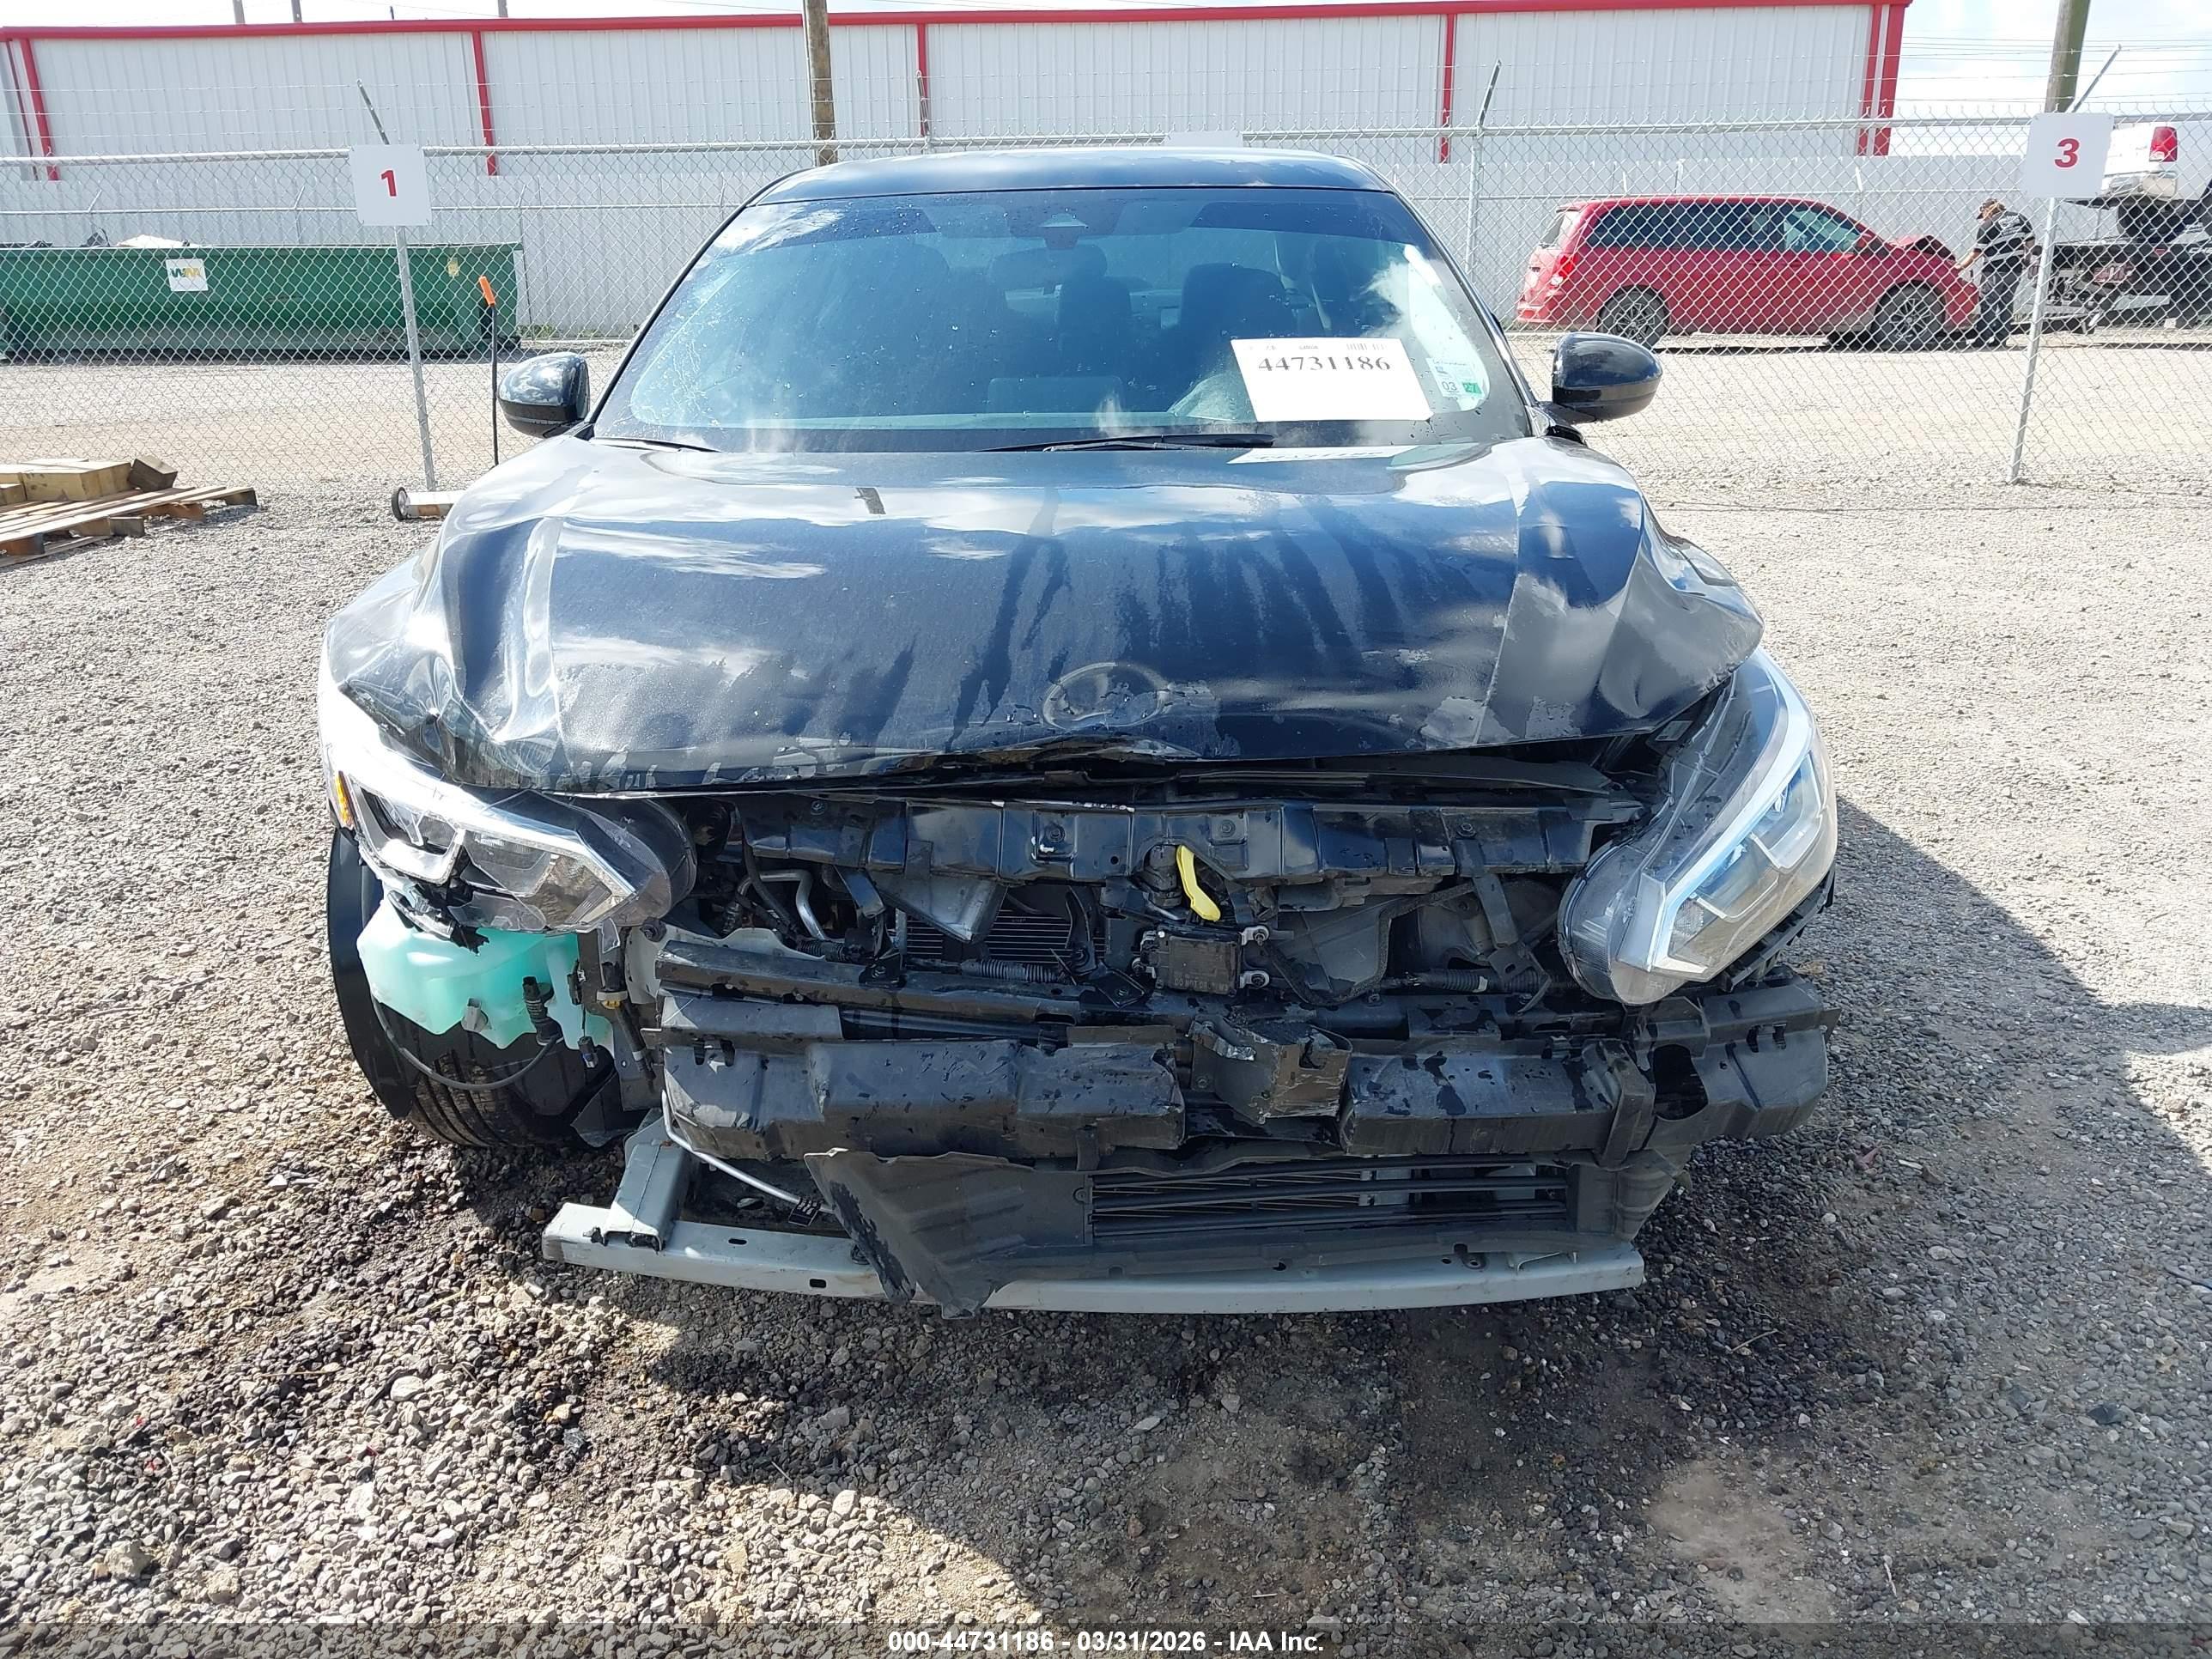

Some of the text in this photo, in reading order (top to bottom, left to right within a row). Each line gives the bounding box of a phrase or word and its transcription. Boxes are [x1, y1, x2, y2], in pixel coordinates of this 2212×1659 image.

[2054, 137, 2080, 168] 3
[380, 169, 397, 197] 1
[1258, 356, 1391, 372] 44731186
[1441, 380, 1457, 392] 03
